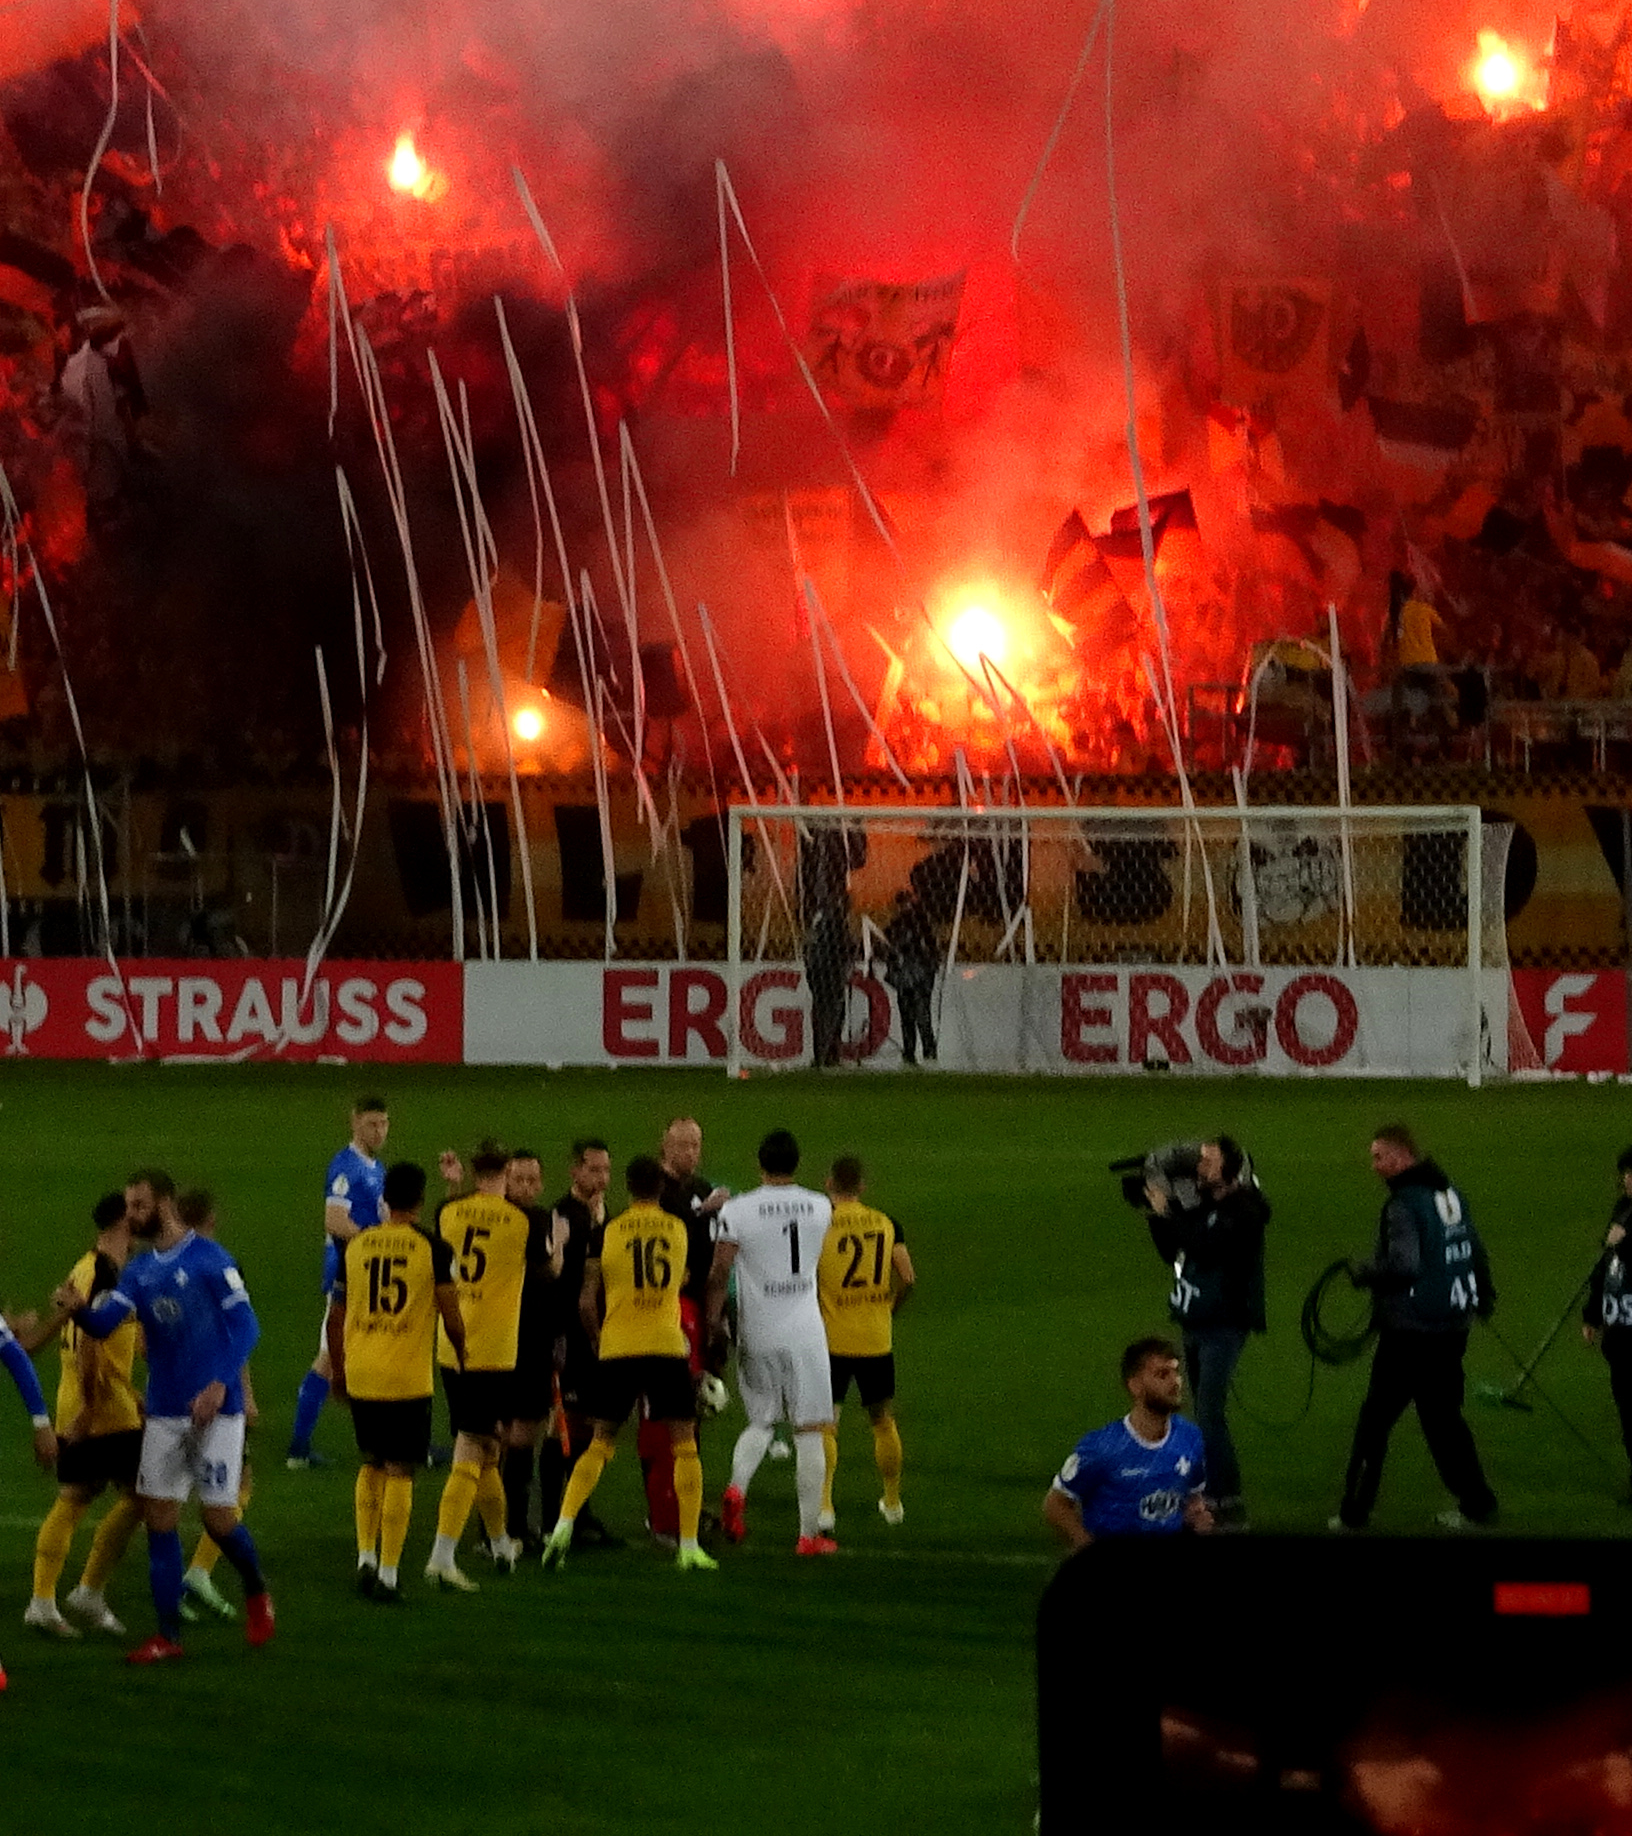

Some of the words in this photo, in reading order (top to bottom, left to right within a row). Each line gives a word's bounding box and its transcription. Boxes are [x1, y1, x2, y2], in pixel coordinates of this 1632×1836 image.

[84, 976, 429, 1047] STRAUSS
[1060, 974, 1359, 1068] ERGO
[459, 1225, 491, 1284] 5
[625, 1236, 672, 1289] 16
[782, 1219, 800, 1275] 1
[837, 1230, 885, 1289] 27
[363, 1256, 409, 1315] 15
